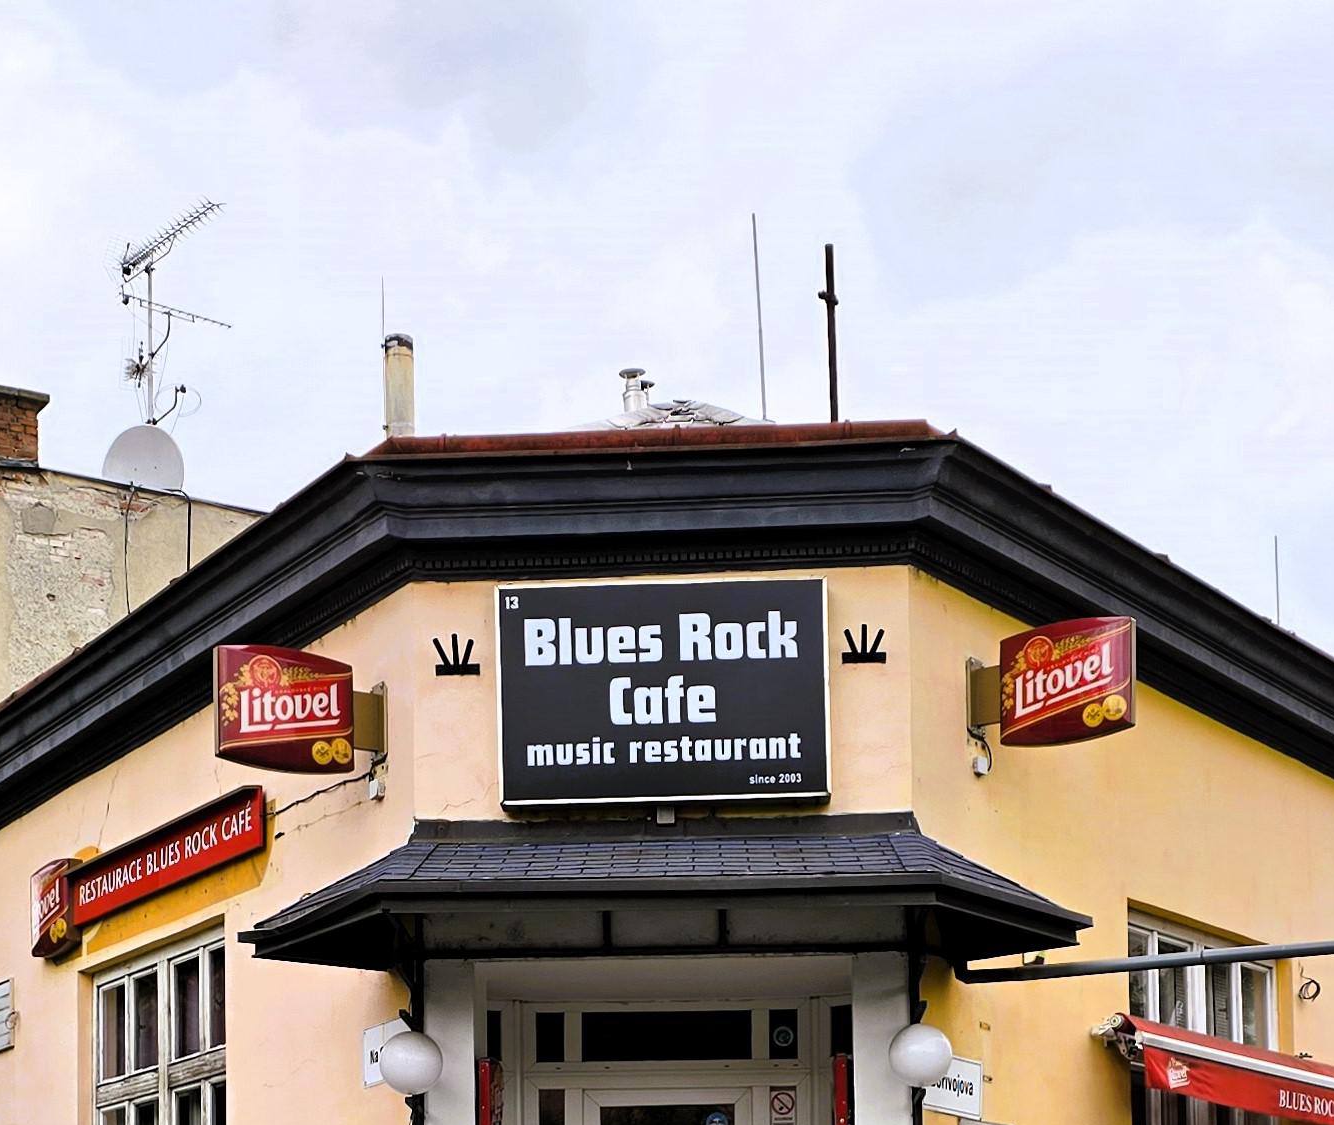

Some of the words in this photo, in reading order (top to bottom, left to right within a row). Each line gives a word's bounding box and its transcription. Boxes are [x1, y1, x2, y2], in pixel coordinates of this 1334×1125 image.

[505, 596, 519, 609] 13
[523, 617, 663, 667] Blues
[678, 610, 799, 661] Rock
[609, 675, 717, 725] Cafe
[1014, 640, 1114, 719] Litovel
[239, 683, 341, 733] Litovel
[526, 736, 616, 767] music
[629, 732, 802, 764] restaurant
[749, 774, 776, 785] since
[778, 772, 802, 784] 2003
[78, 857, 142, 907] RESTAURACE
[146, 840, 181, 876] BLUES
[184, 823, 218, 860] ROCK
[221, 800, 253, 841] CAFÉ
[1279, 1089, 1312, 1113] BLUES
